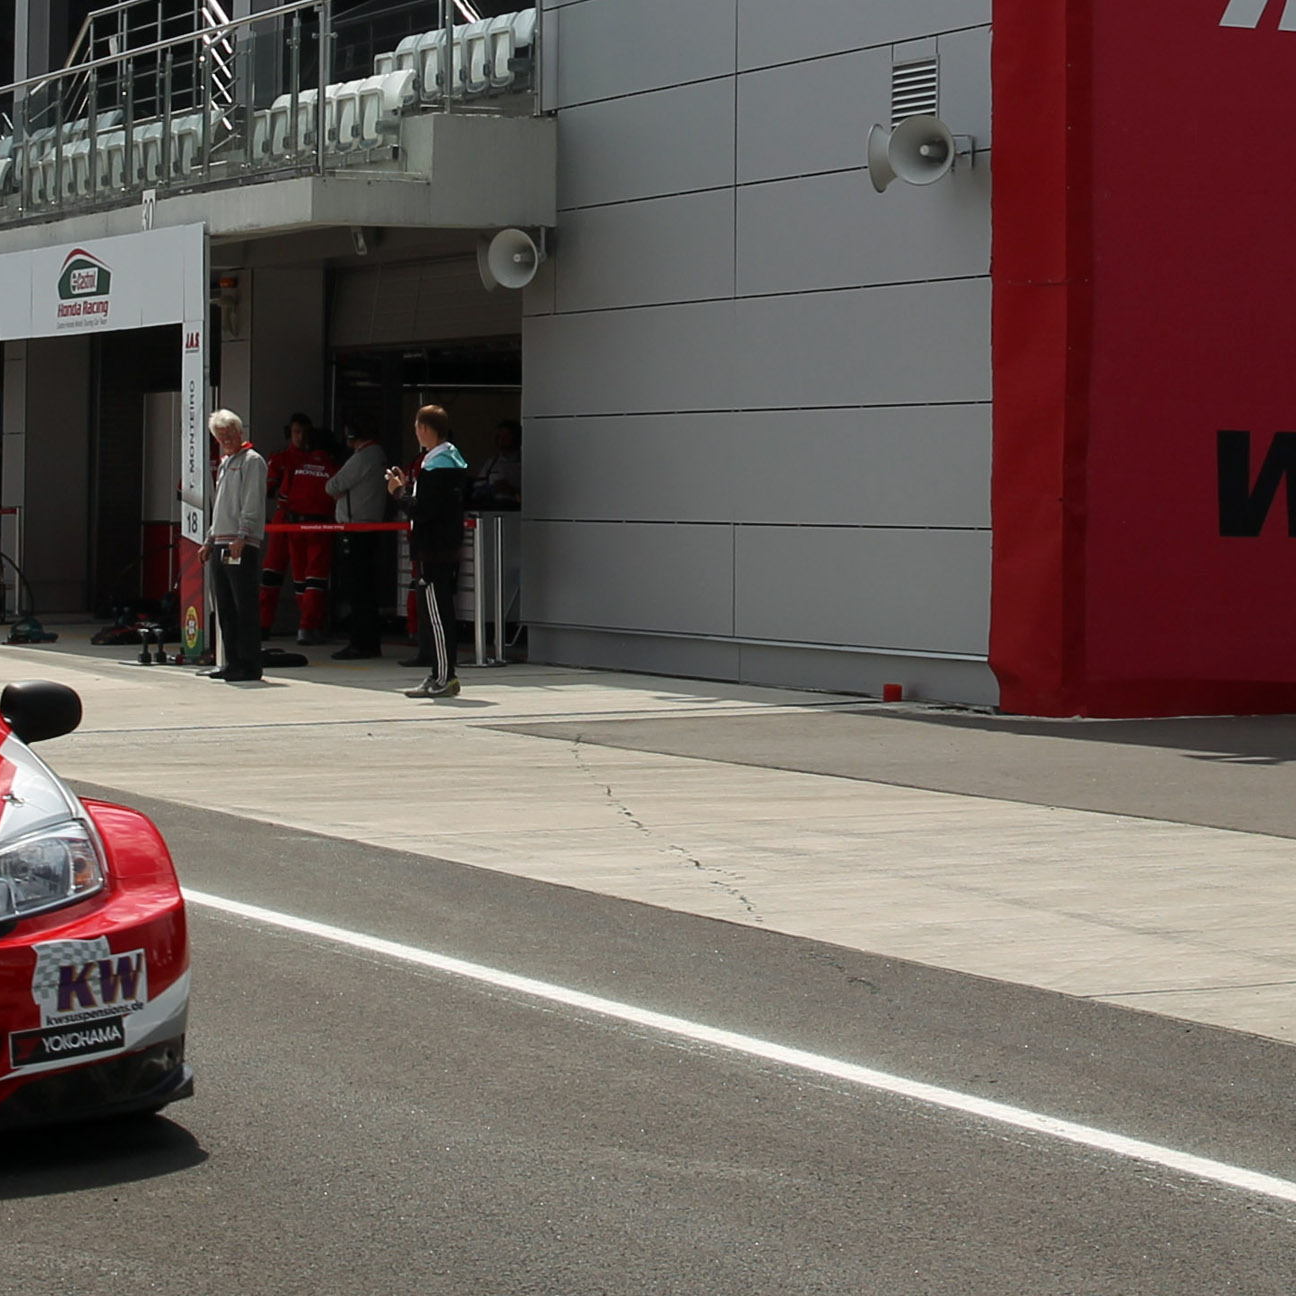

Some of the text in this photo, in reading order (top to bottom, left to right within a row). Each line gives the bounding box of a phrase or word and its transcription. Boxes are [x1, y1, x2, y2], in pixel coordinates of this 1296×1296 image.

[57, 300, 109, 318] Honda Racing
[187, 511, 198, 534] 18
[57, 952, 144, 1013] KW
[45, 999, 145, 1027] kwsuspensions.de
[32, 1024, 123, 1054] YOKOHAMA
